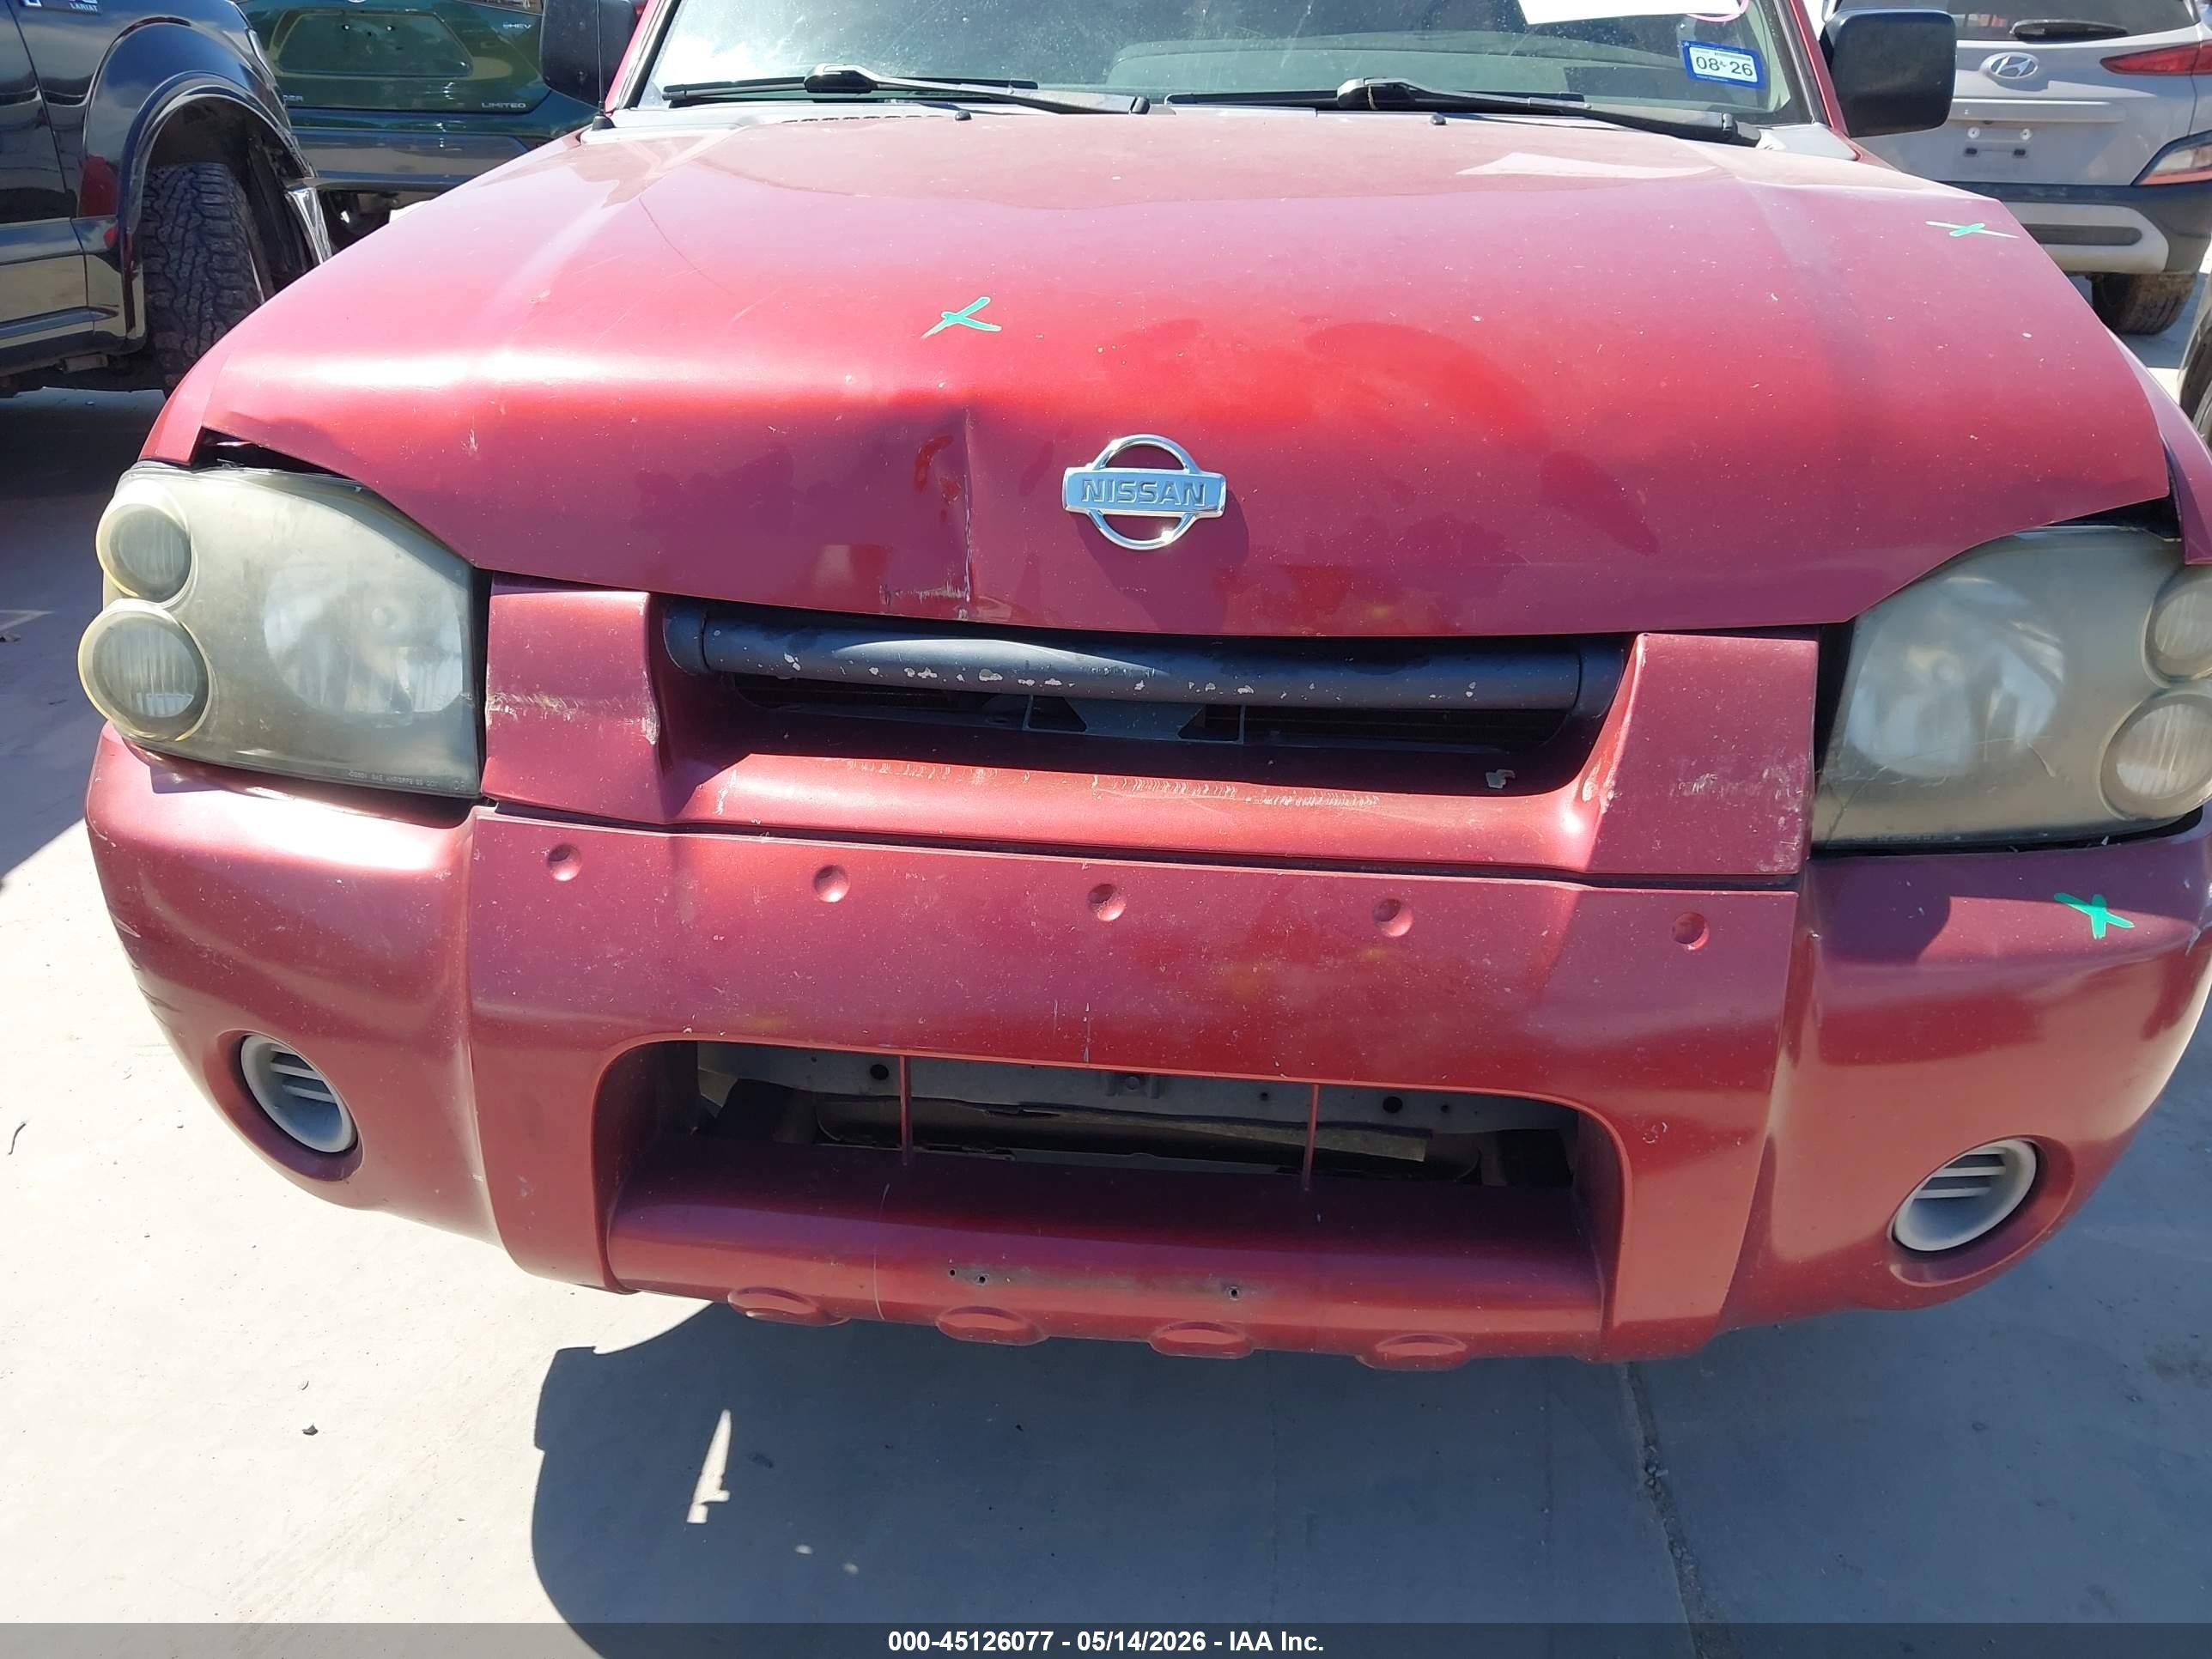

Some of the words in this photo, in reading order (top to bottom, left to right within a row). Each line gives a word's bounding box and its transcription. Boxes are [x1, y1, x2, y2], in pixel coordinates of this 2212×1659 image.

[69, 3, 98, 12] LARIAT
[1696, 56, 1720, 71] 08
[1729, 61, 1753, 76] 26
[1081, 479, 1206, 507] NISSAN
